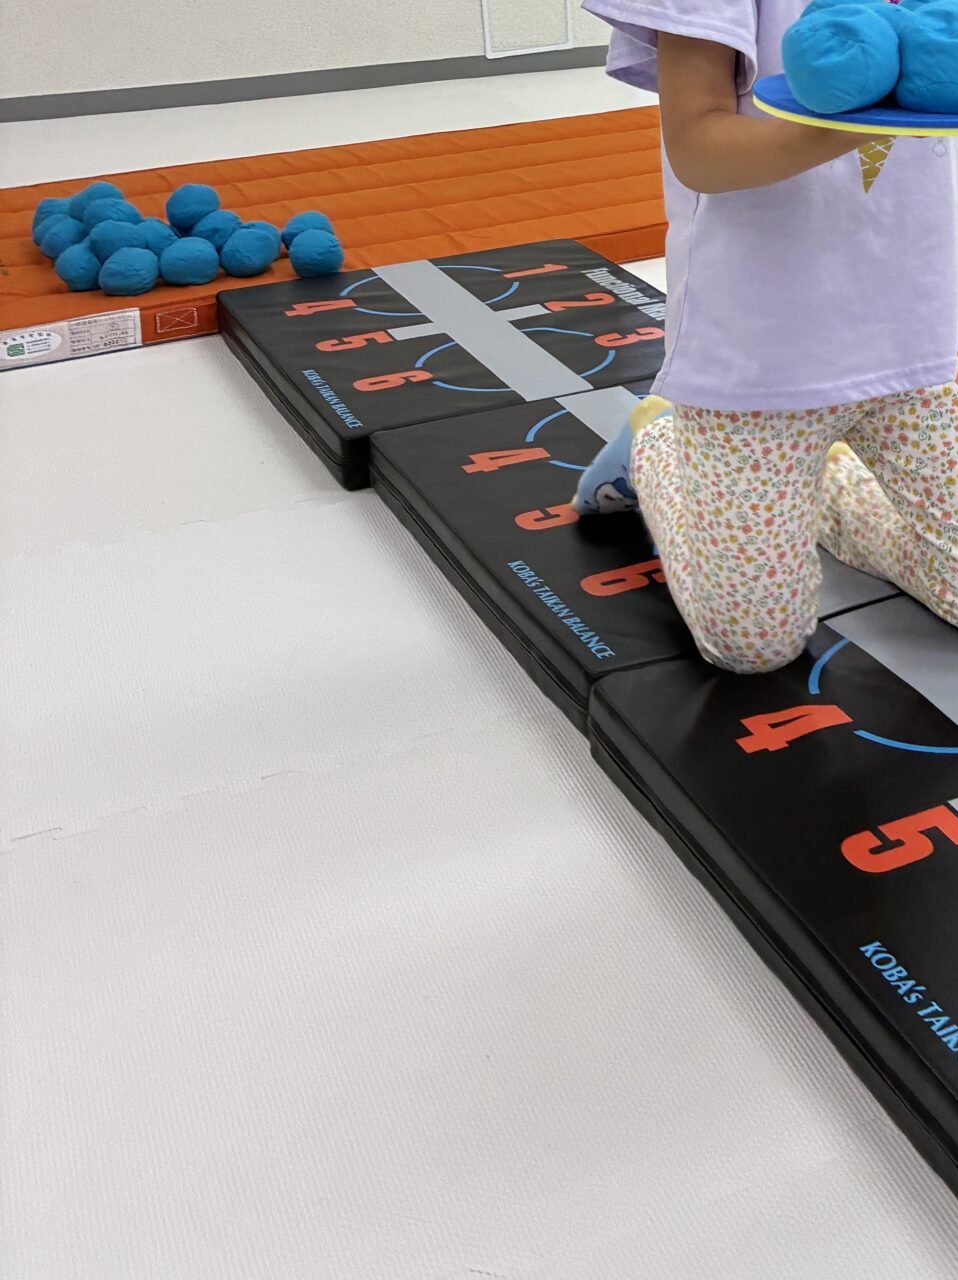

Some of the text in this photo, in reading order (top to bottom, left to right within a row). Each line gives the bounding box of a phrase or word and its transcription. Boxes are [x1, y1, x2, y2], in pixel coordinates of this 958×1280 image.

[503, 264, 569, 278] 1
[284, 298, 361, 317] 4
[545, 293, 616, 312] 2
[315, 329, 393, 352] 5
[594, 327, 665, 348] 3
[352, 370, 433, 392] 6
[462, 447, 551, 474] 4
[580, 559, 667, 597] 6
[507, 560, 616, 660] KOBA's TAIKAN BALANCE
[735, 704, 853, 753] 4
[859, 941, 926, 1004] KOBA's
